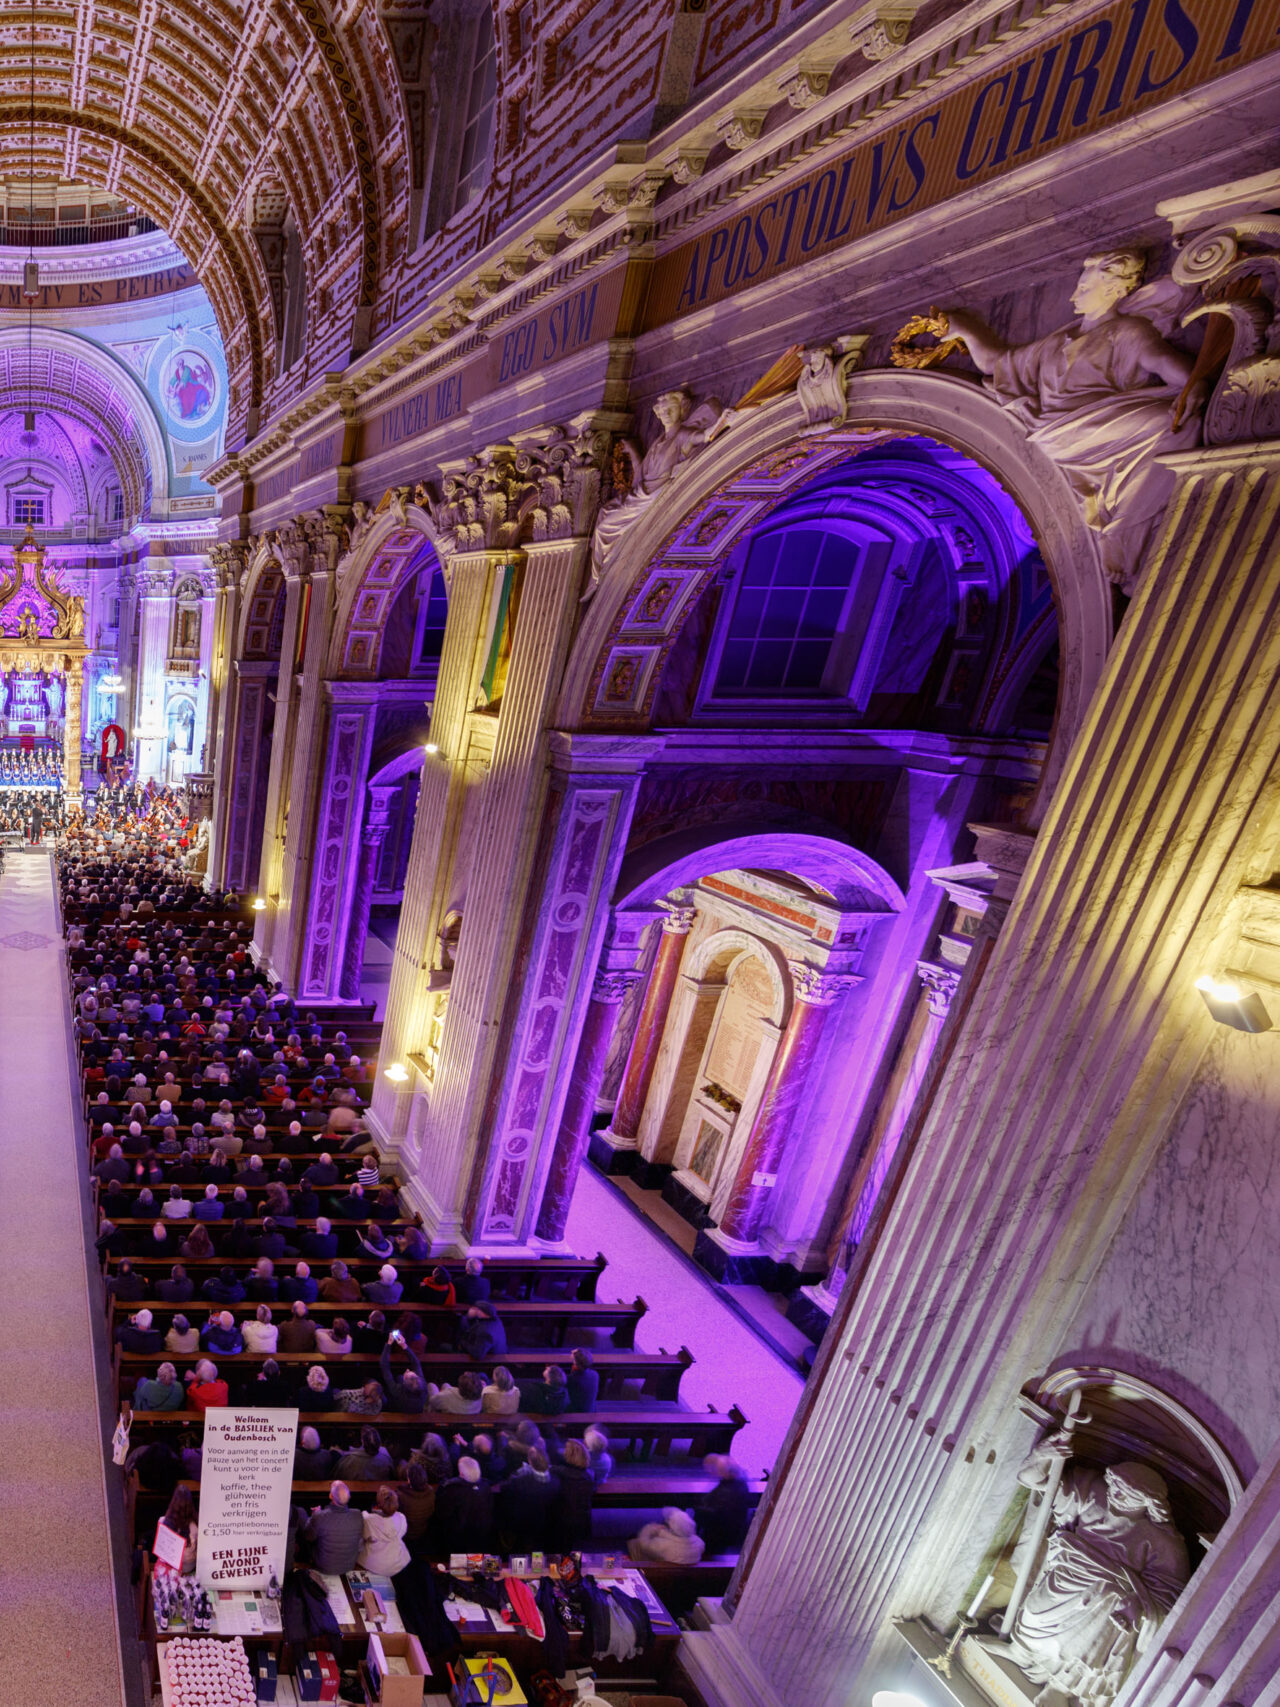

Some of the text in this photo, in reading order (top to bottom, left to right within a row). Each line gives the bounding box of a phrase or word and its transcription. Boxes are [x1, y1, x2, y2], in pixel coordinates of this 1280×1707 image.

[433, 371, 464, 424] MEA
[498, 317, 539, 384] EGO
[541, 282, 599, 362] SVM
[676, 109, 942, 312] APOSTOLVS
[40, 285, 64, 305] TV
[78, 283, 104, 304] ES
[115, 265, 189, 300] PETRVS
[224, 1434, 276, 1442] Oudenbosch
[221, 1483, 248, 1491] koffie,
[222, 1510, 267, 1518] verkrijgen
[212, 1528, 231, 1537] 1,50
[212, 1546, 268, 1560] EEN FIJNE
[222, 1556, 260, 1569] AVOND
[211, 1565, 264, 1580] GEWENST
